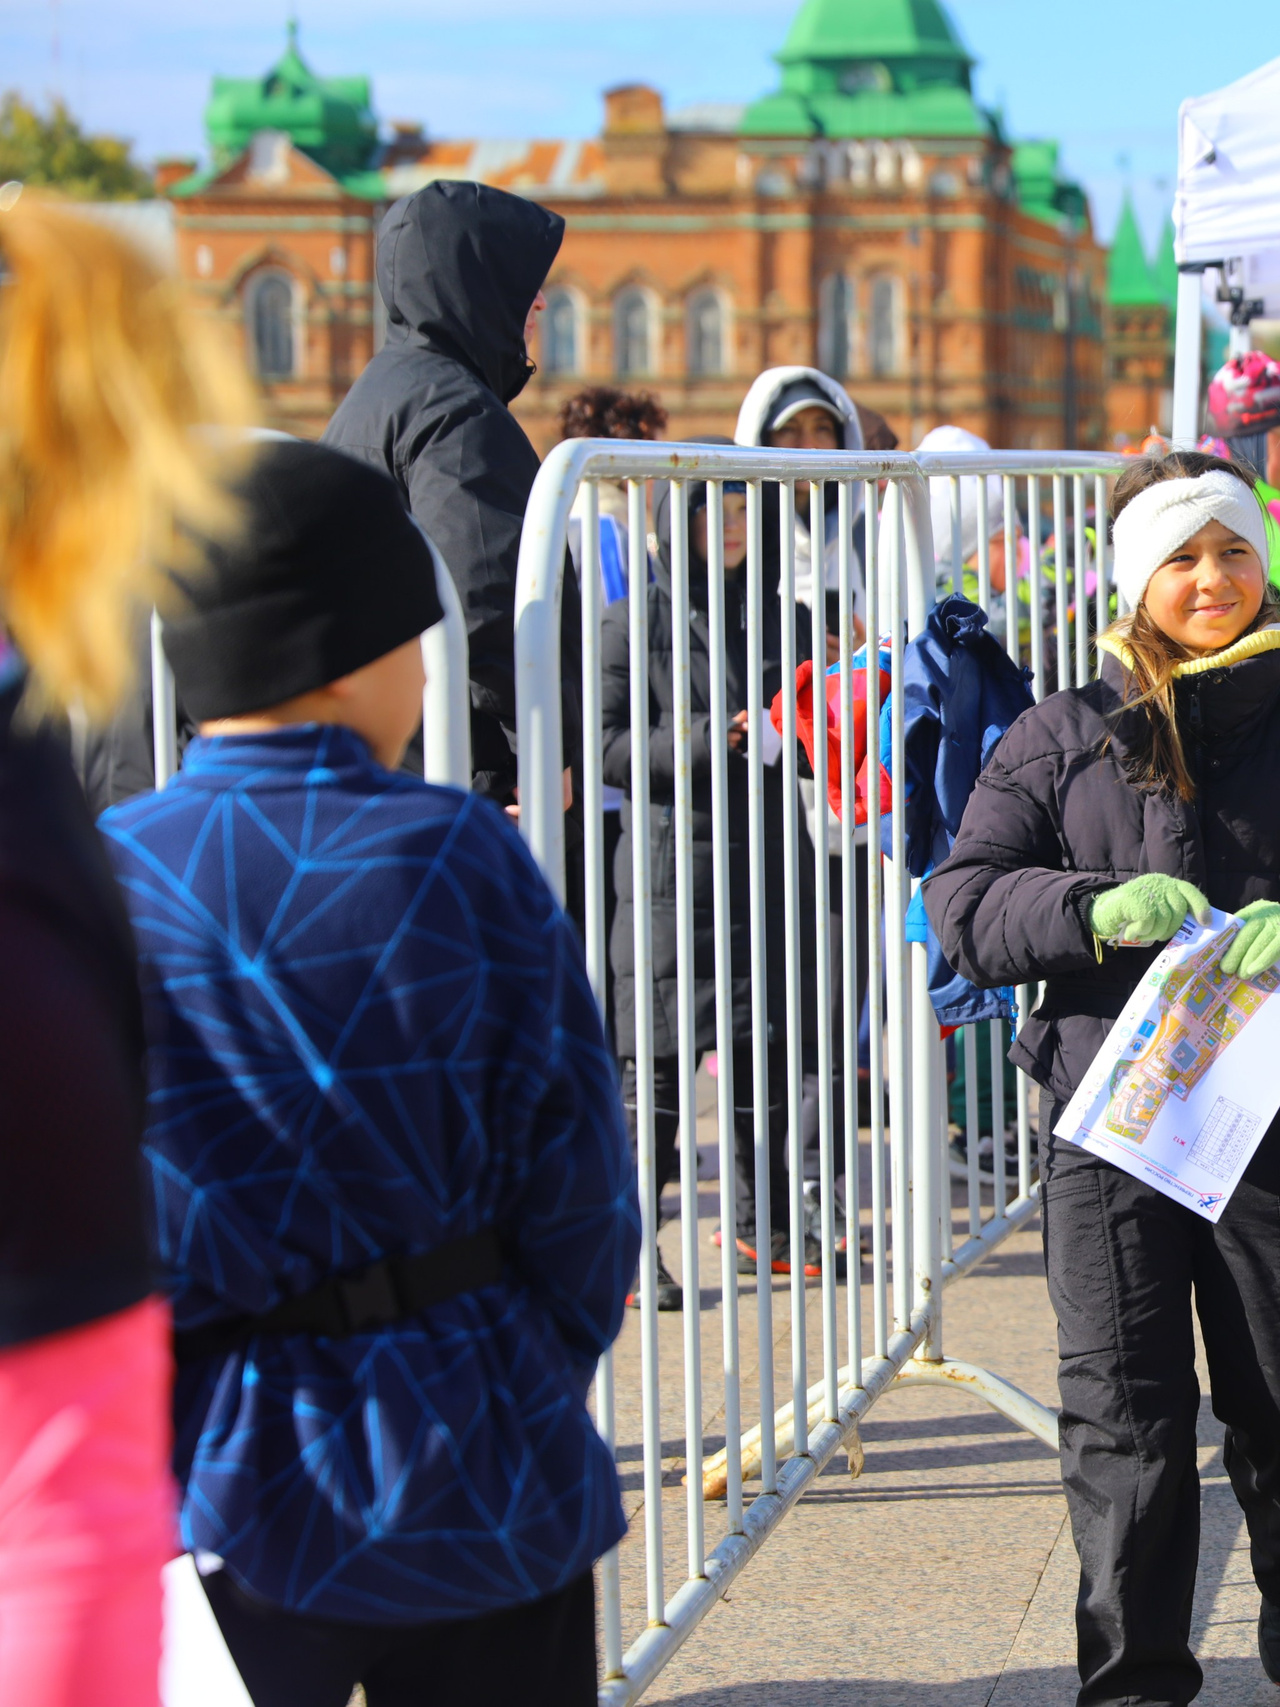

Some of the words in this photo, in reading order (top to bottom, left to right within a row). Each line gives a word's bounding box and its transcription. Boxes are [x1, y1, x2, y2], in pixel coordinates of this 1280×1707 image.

[1172, 1135, 1186, 1147] Ж12
[1143, 1166, 1165, 1181] РОССИИ
[1163, 1177, 1195, 1198] ПЕРВЕНСТВО
